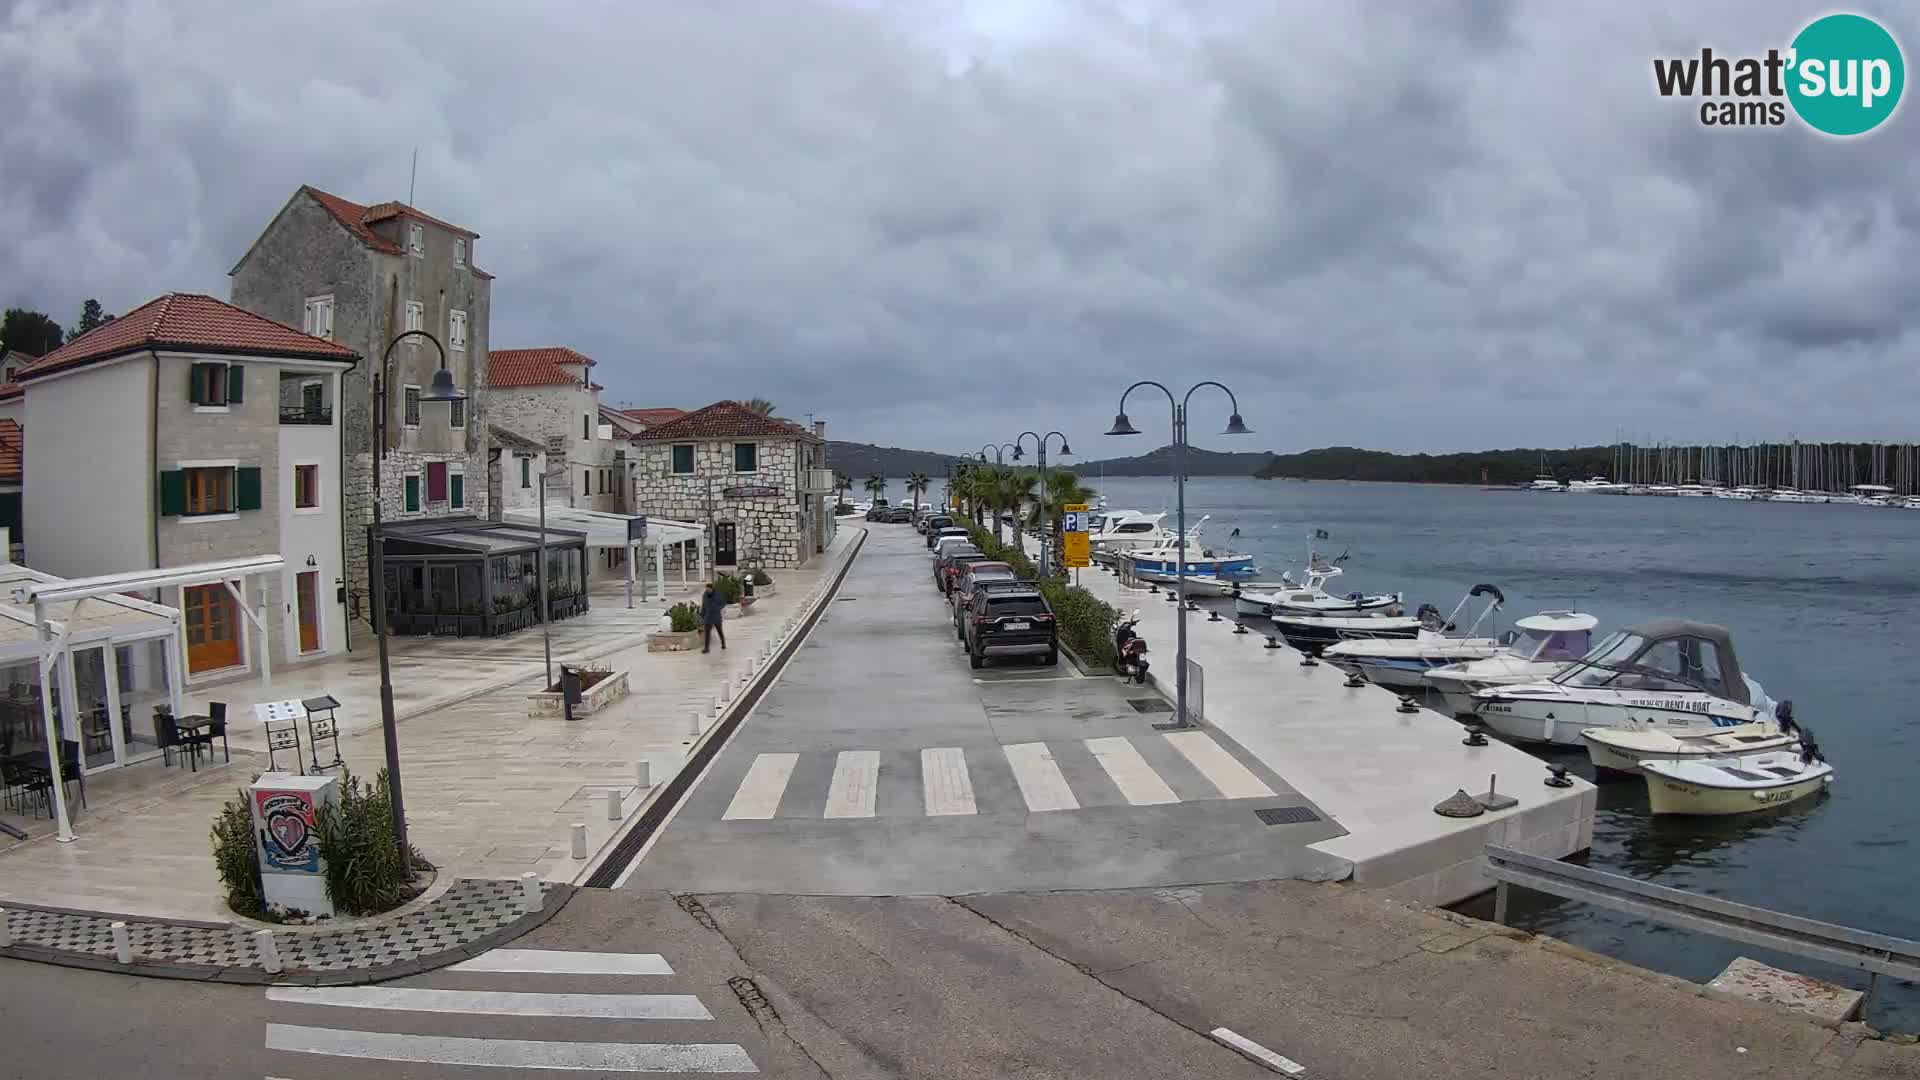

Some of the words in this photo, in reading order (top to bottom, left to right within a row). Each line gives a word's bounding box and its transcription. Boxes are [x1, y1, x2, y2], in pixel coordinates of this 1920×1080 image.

[1066, 514, 1076, 530] P
[1664, 700, 1684, 709] RENT
[1685, 701, 1690, 710] A
[1692, 701, 1711, 713] BOAT
